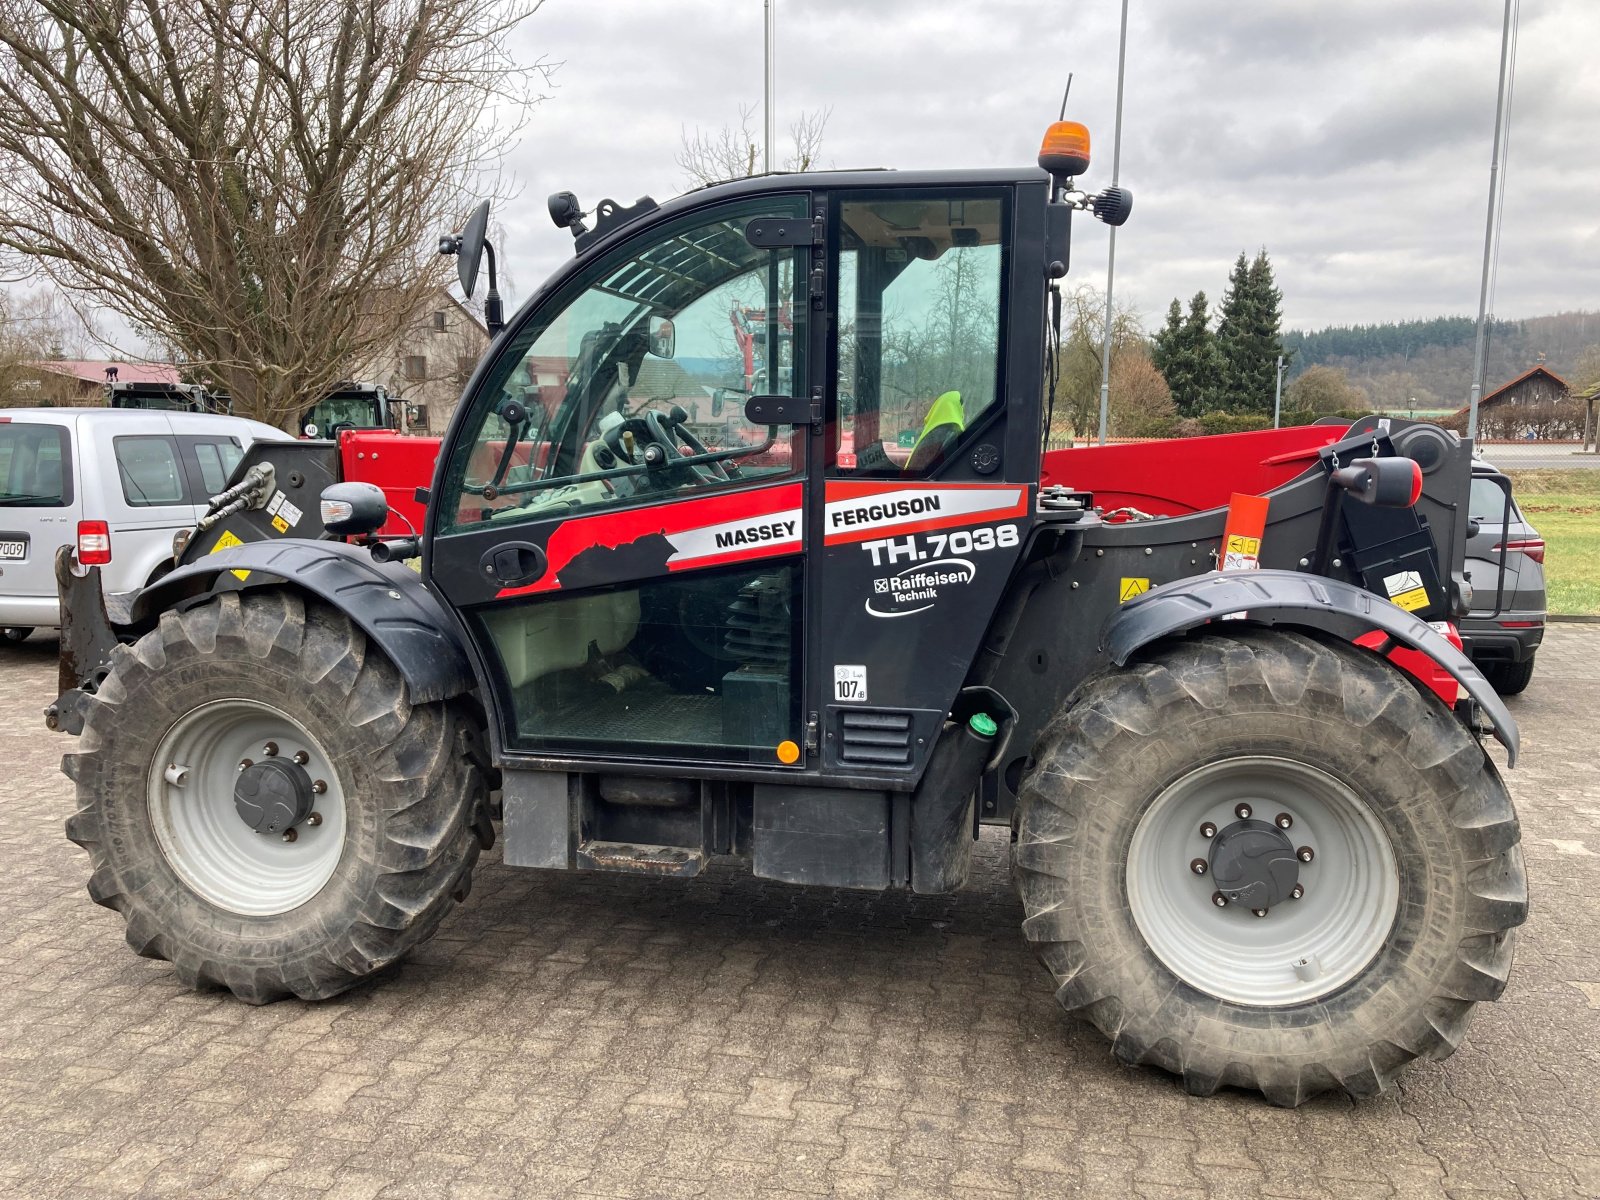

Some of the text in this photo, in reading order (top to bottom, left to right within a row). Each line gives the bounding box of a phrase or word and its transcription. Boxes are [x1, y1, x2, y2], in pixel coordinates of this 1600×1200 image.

[308, 426, 315, 434] 40
[715, 495, 941, 548] MASSEY FERGUSON
[861, 524, 1020, 566] TH.7038
[890, 569, 968, 591] Raiffeisen
[892, 587, 938, 603] Technik
[836, 680, 858, 698] 107
